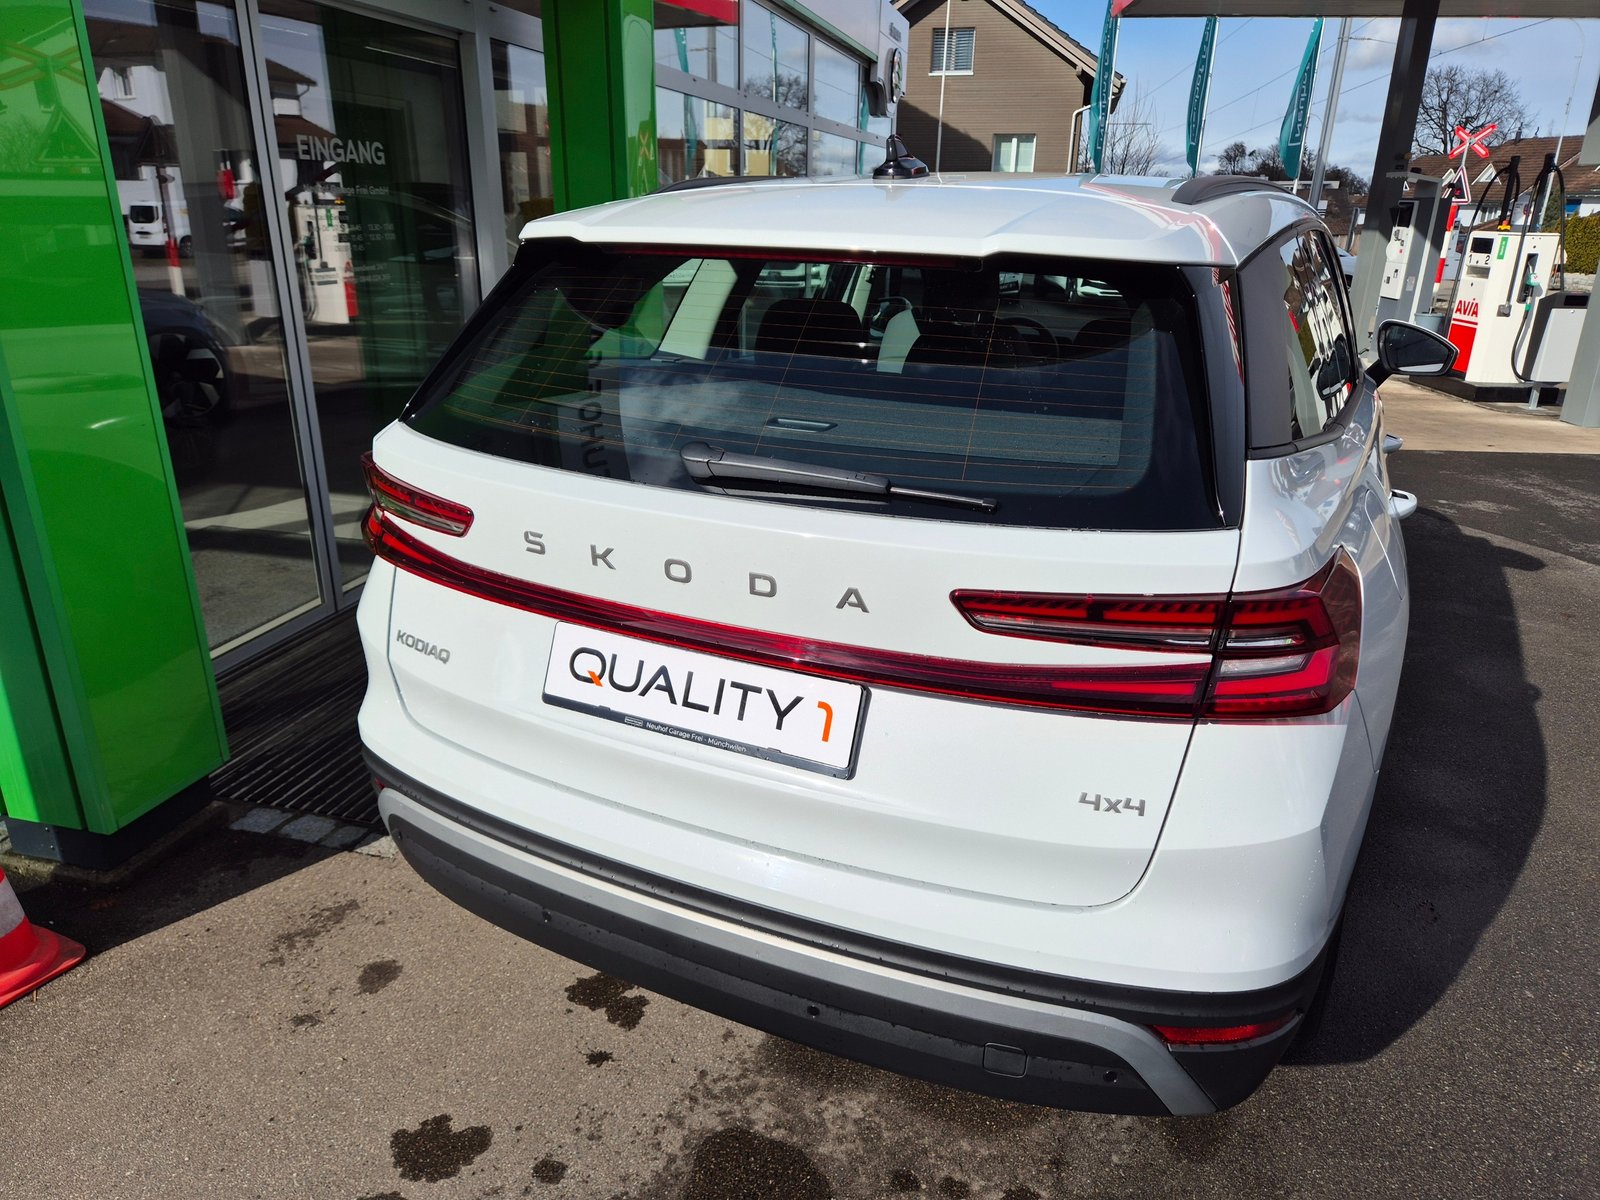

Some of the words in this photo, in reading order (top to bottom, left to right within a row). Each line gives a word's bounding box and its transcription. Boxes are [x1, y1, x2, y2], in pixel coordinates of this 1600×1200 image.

[296, 134, 386, 165] EINGANG
[1468, 254, 1473, 265] 1
[1484, 255, 1491, 265] 2
[1455, 298, 1479, 317] AVIA
[523, 530, 870, 613] SKODA
[396, 629, 451, 664] KODIAQ
[569, 646, 805, 731] QUALITY
[817, 700, 834, 743] 1
[646, 721, 669, 733] Neuhof
[668, 727, 691, 740] Garage
[691, 733, 704, 742] Frei
[708, 737, 747, 753] Münchwilen
[1078, 791, 1146, 817] 4x4
